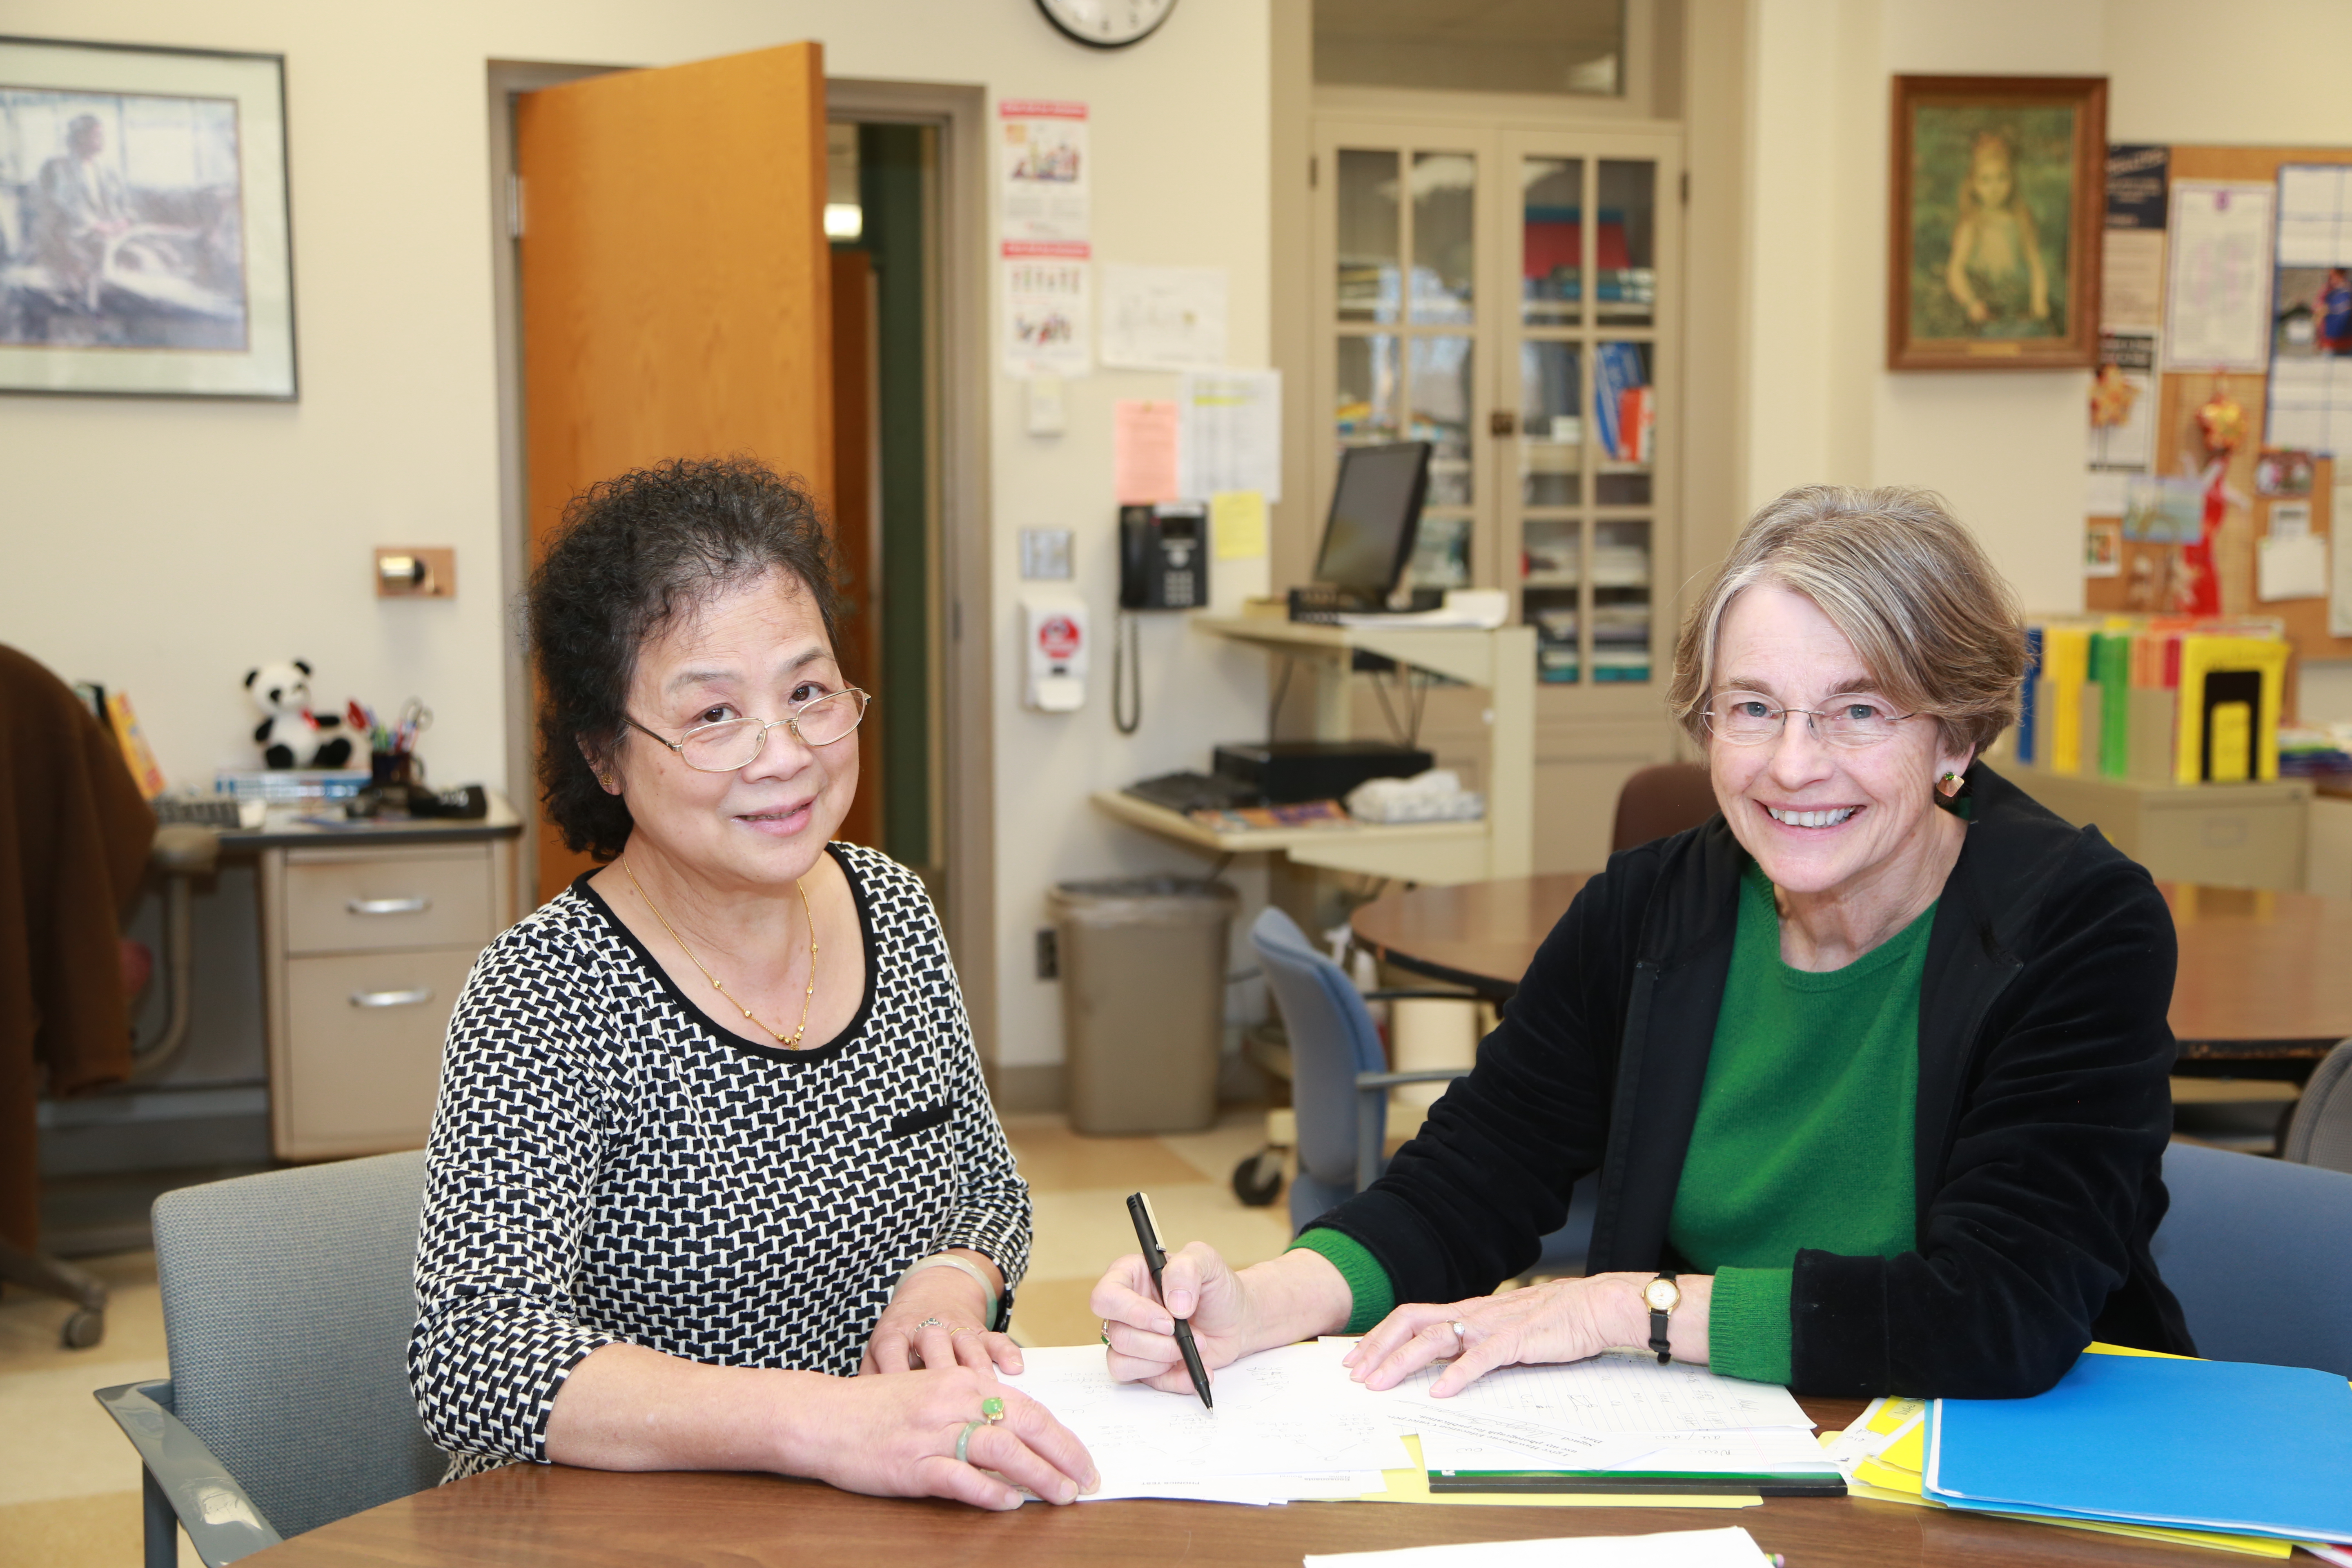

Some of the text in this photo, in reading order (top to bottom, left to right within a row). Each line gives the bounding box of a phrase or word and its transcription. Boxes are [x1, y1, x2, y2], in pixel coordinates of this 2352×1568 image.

[1403, 1417, 1436, 1427] Center
[1438, 1424, 1485, 1438] Education
[1485, 1428, 1542, 1446] photograph
[1486, 1434, 1539, 1451] Hawthorne
[1561, 1436, 1596, 1448] Signed
[1580, 1435, 1603, 1444] Date
